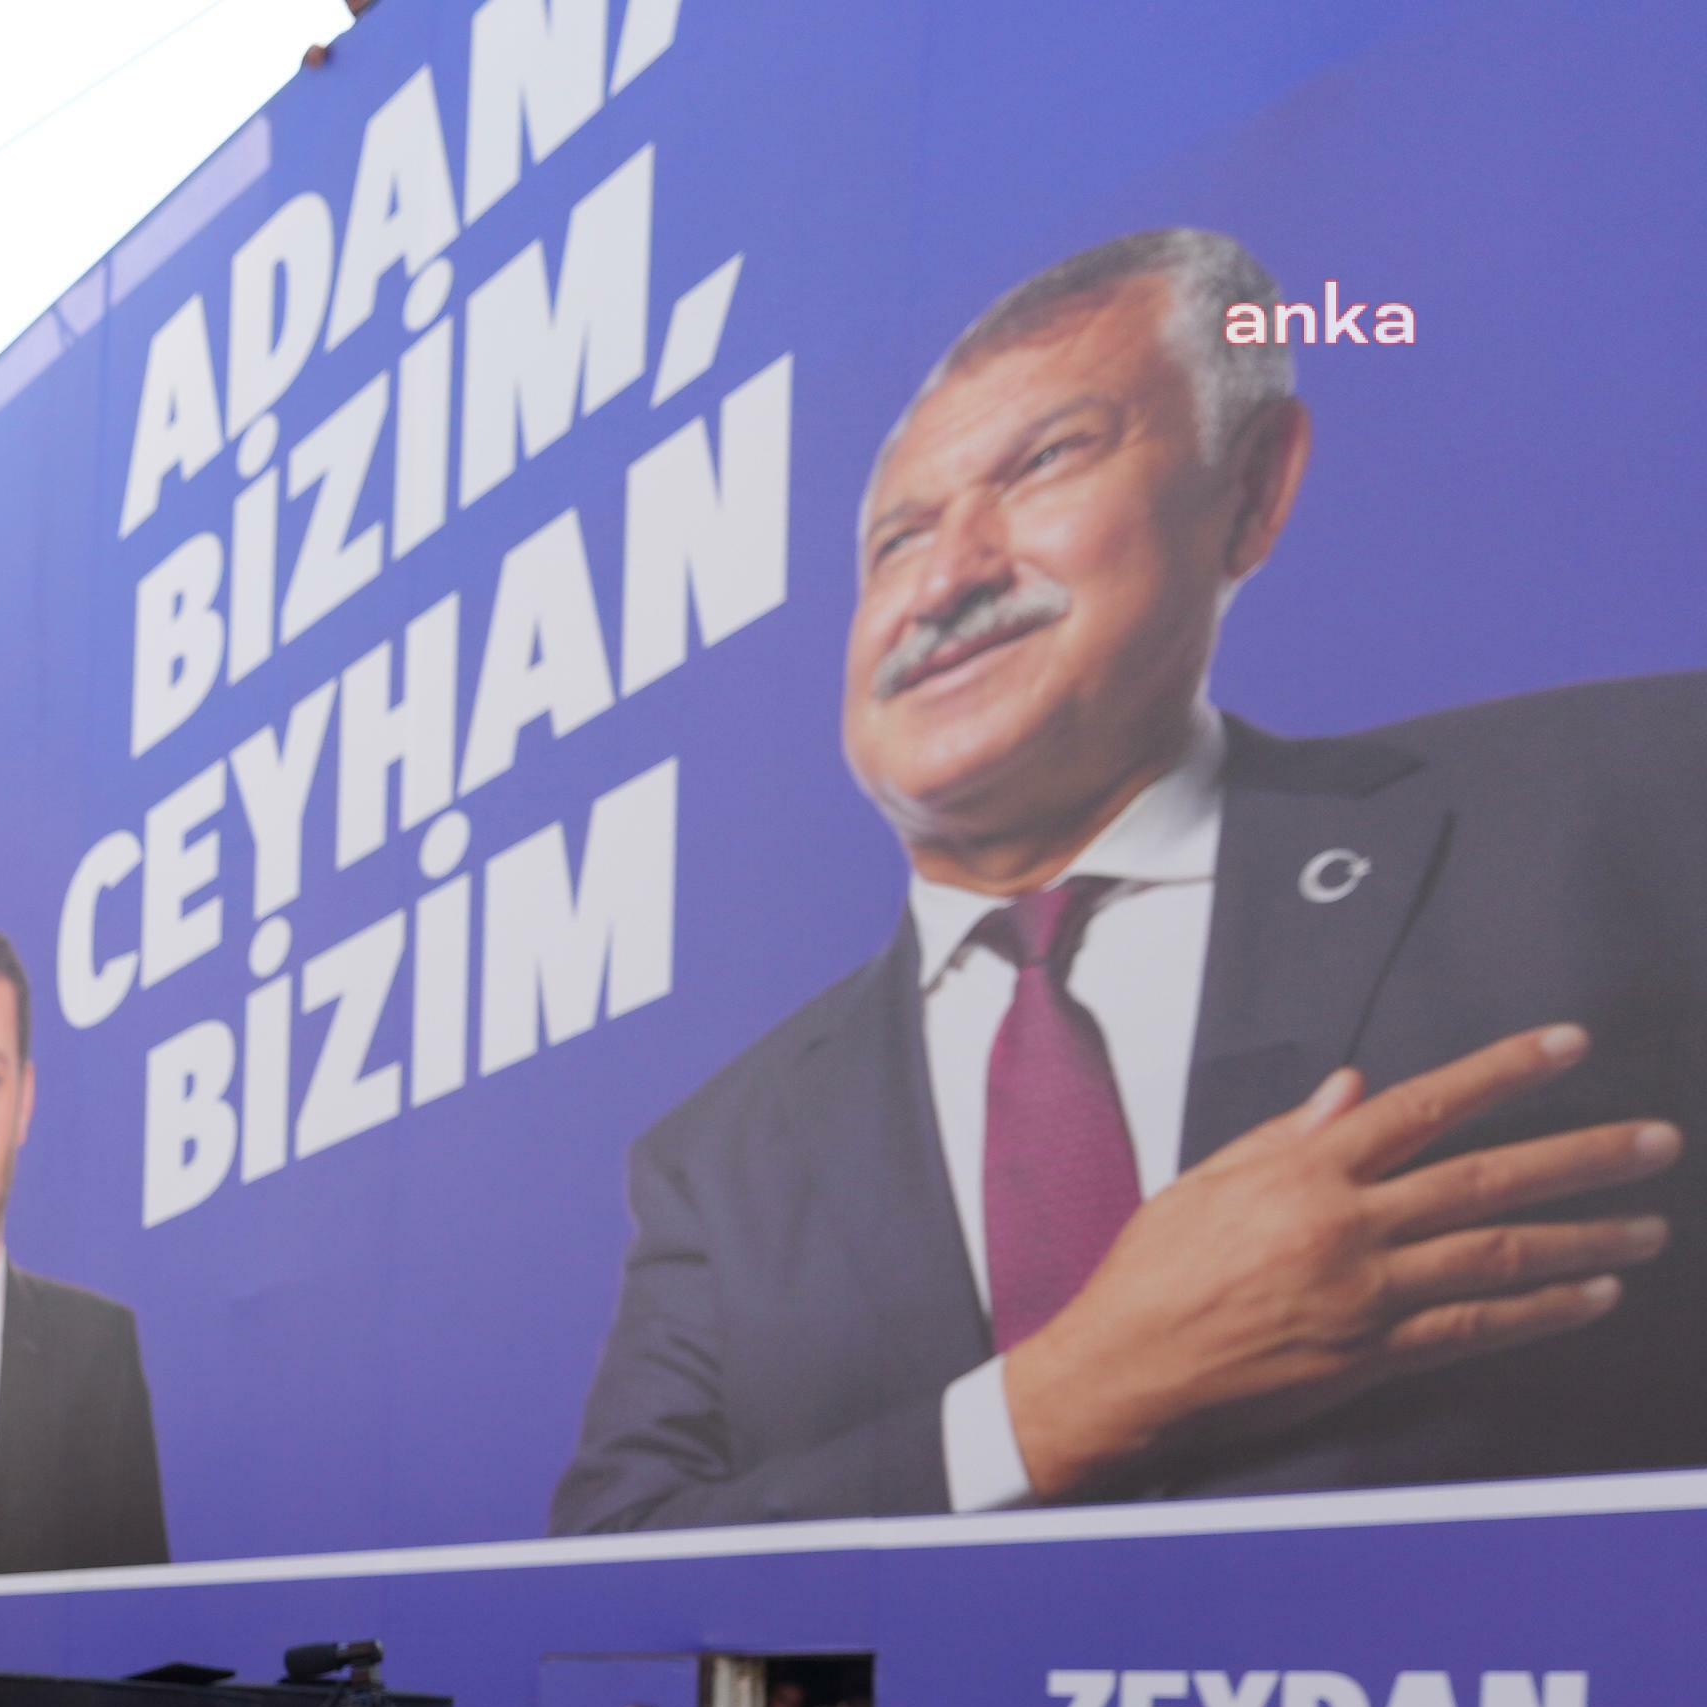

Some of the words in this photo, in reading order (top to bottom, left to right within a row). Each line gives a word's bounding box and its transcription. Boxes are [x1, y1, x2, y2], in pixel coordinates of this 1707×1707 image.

[118, 0, 683, 541] ADAN
[131, 141, 745, 760] BİZİM,
[56, 349, 794, 1031] CEYHAN
[141, 752, 679, 1231] BİZİM
